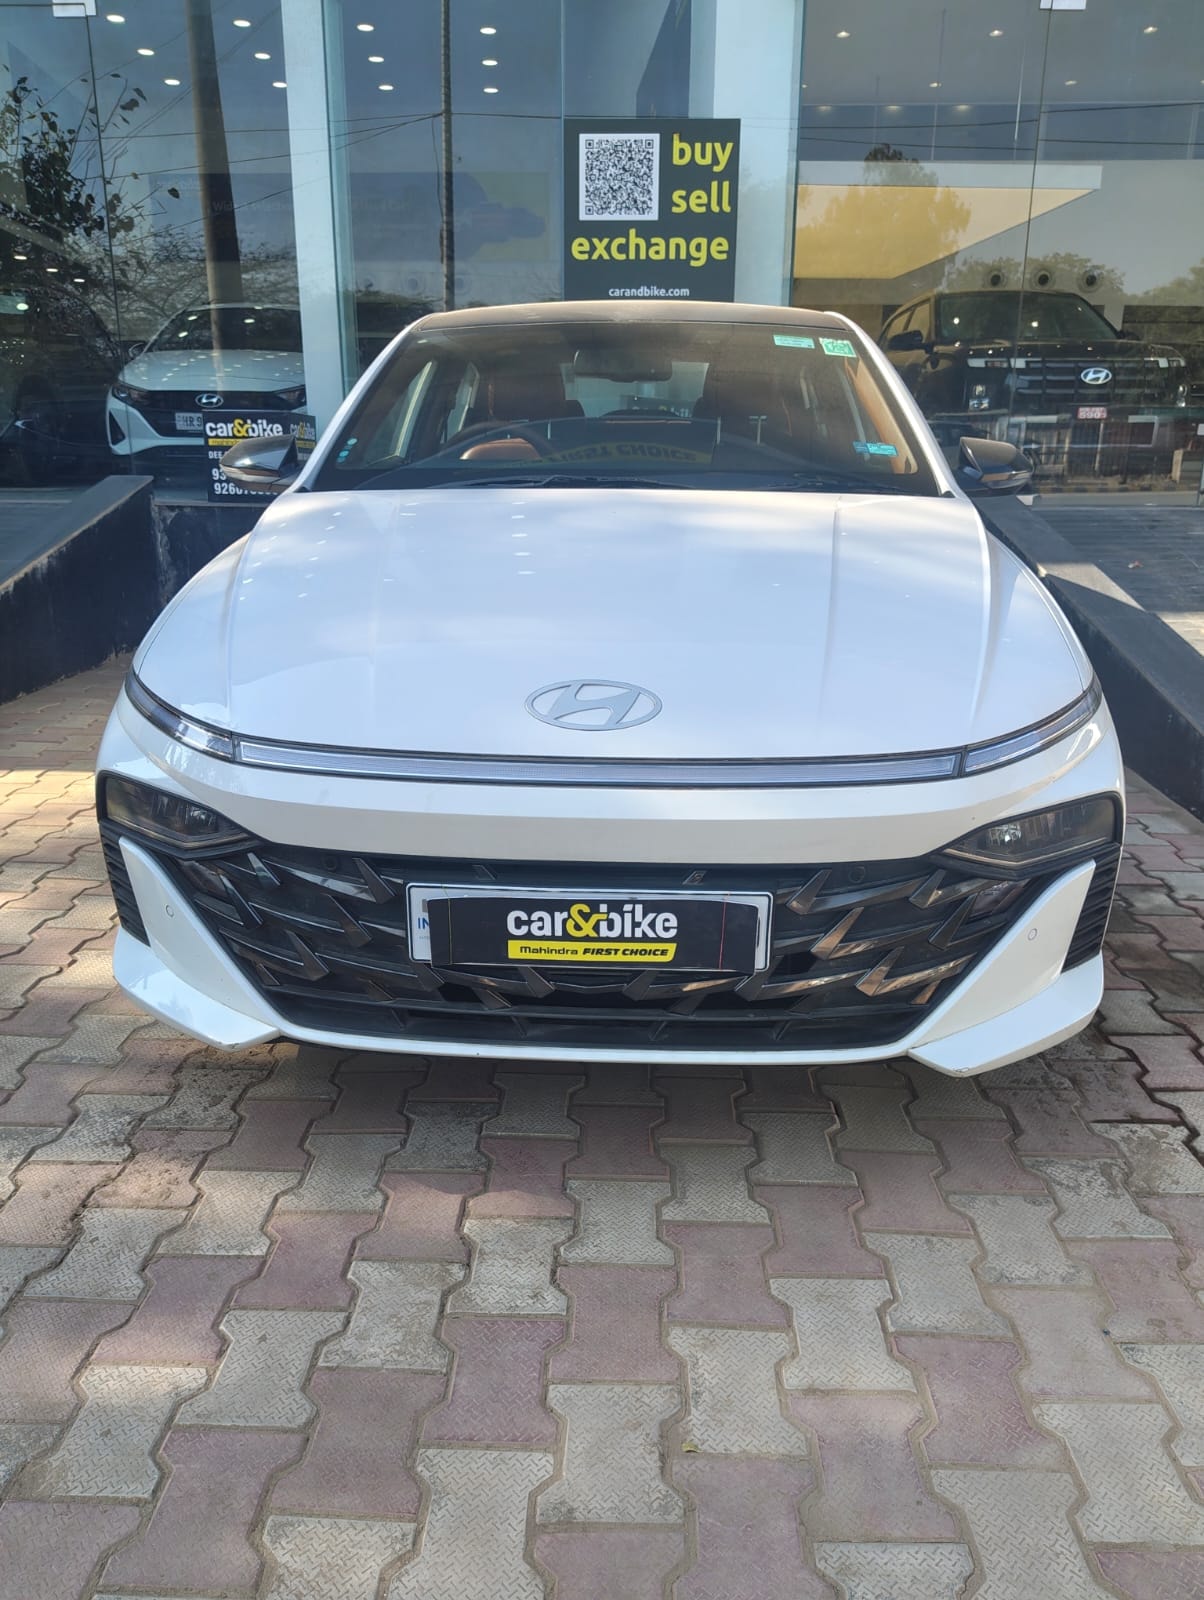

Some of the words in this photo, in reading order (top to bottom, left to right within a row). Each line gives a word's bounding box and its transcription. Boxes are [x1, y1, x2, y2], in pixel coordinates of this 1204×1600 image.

[672, 133, 733, 172] buy
[671, 180, 731, 213] sell
[571, 228, 729, 267] exchange
[608, 286, 690, 297] carandbike.com
[205, 418, 283, 437] car&bike
[211, 468, 227, 480] 93
[506, 903, 678, 938] car&bike
[519, 945, 579, 955] Mahindra
[582, 947, 620, 956] FIRST
[622, 948, 669, 957] CHOICE
